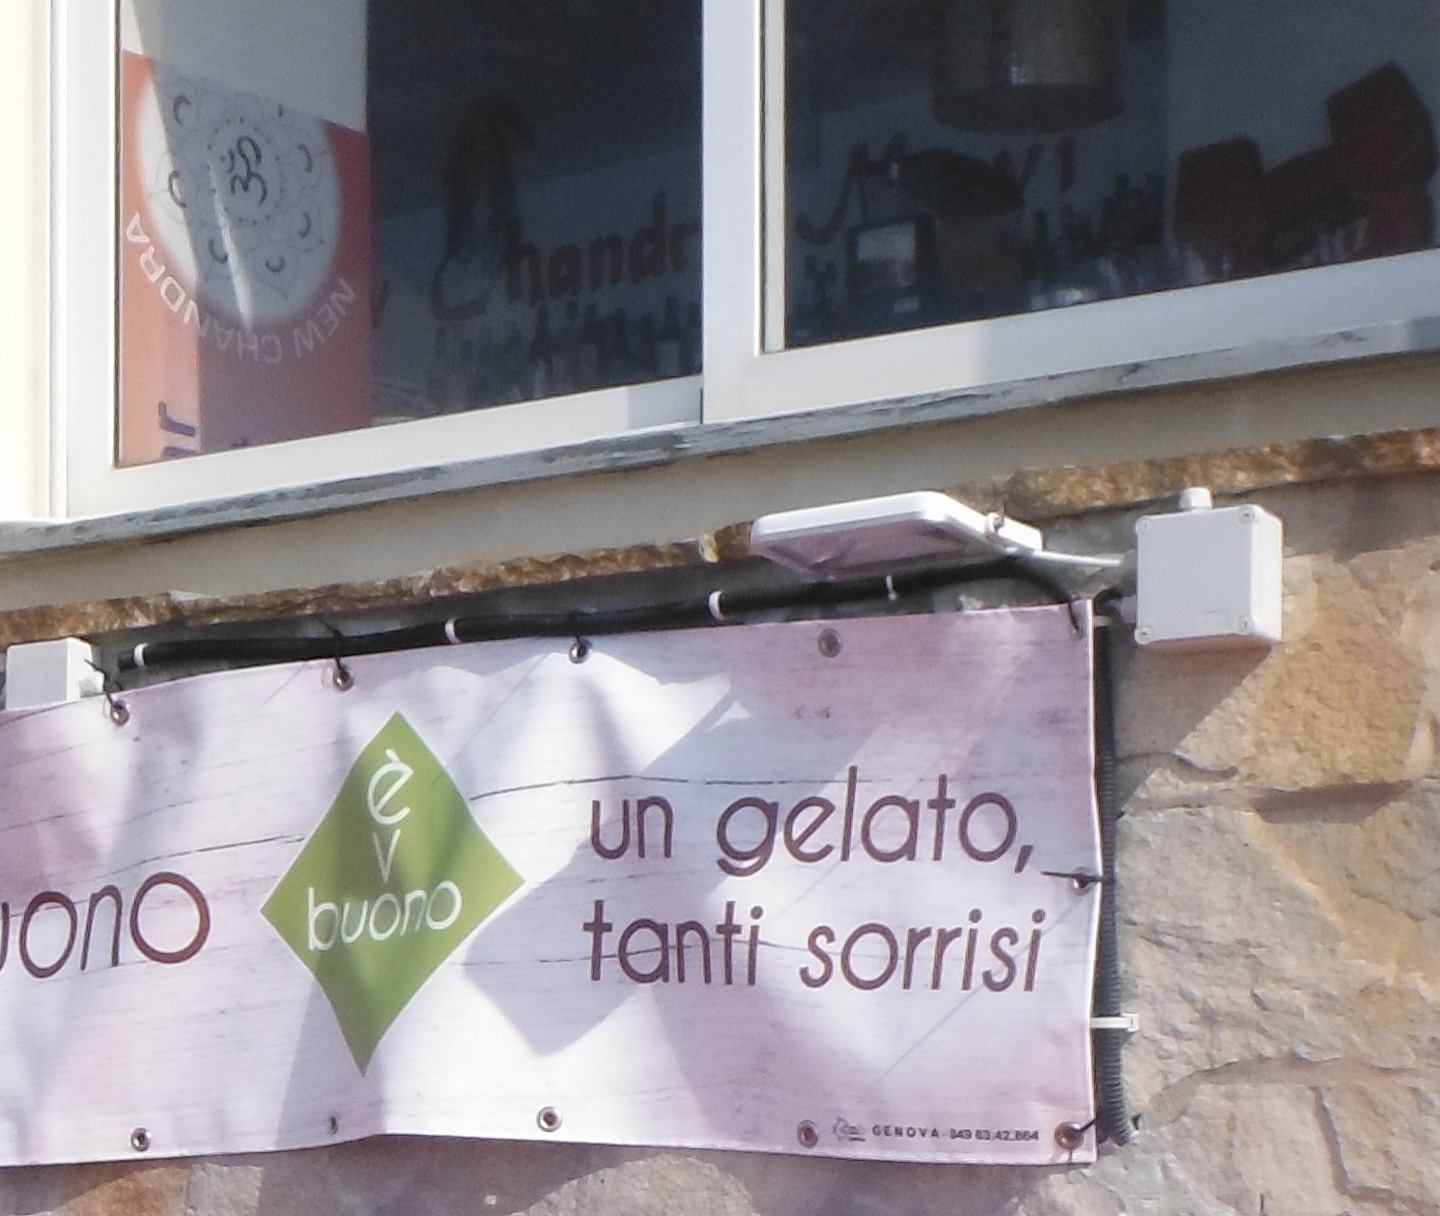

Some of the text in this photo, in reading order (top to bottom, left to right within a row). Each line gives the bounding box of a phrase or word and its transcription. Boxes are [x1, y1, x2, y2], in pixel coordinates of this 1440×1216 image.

[126, 211, 356, 362] NEW CHANDRA
[590, 764, 1034, 877] un gelato,
[307, 880, 462, 952] buono
[582, 900, 1047, 993] tanti sorrisi
